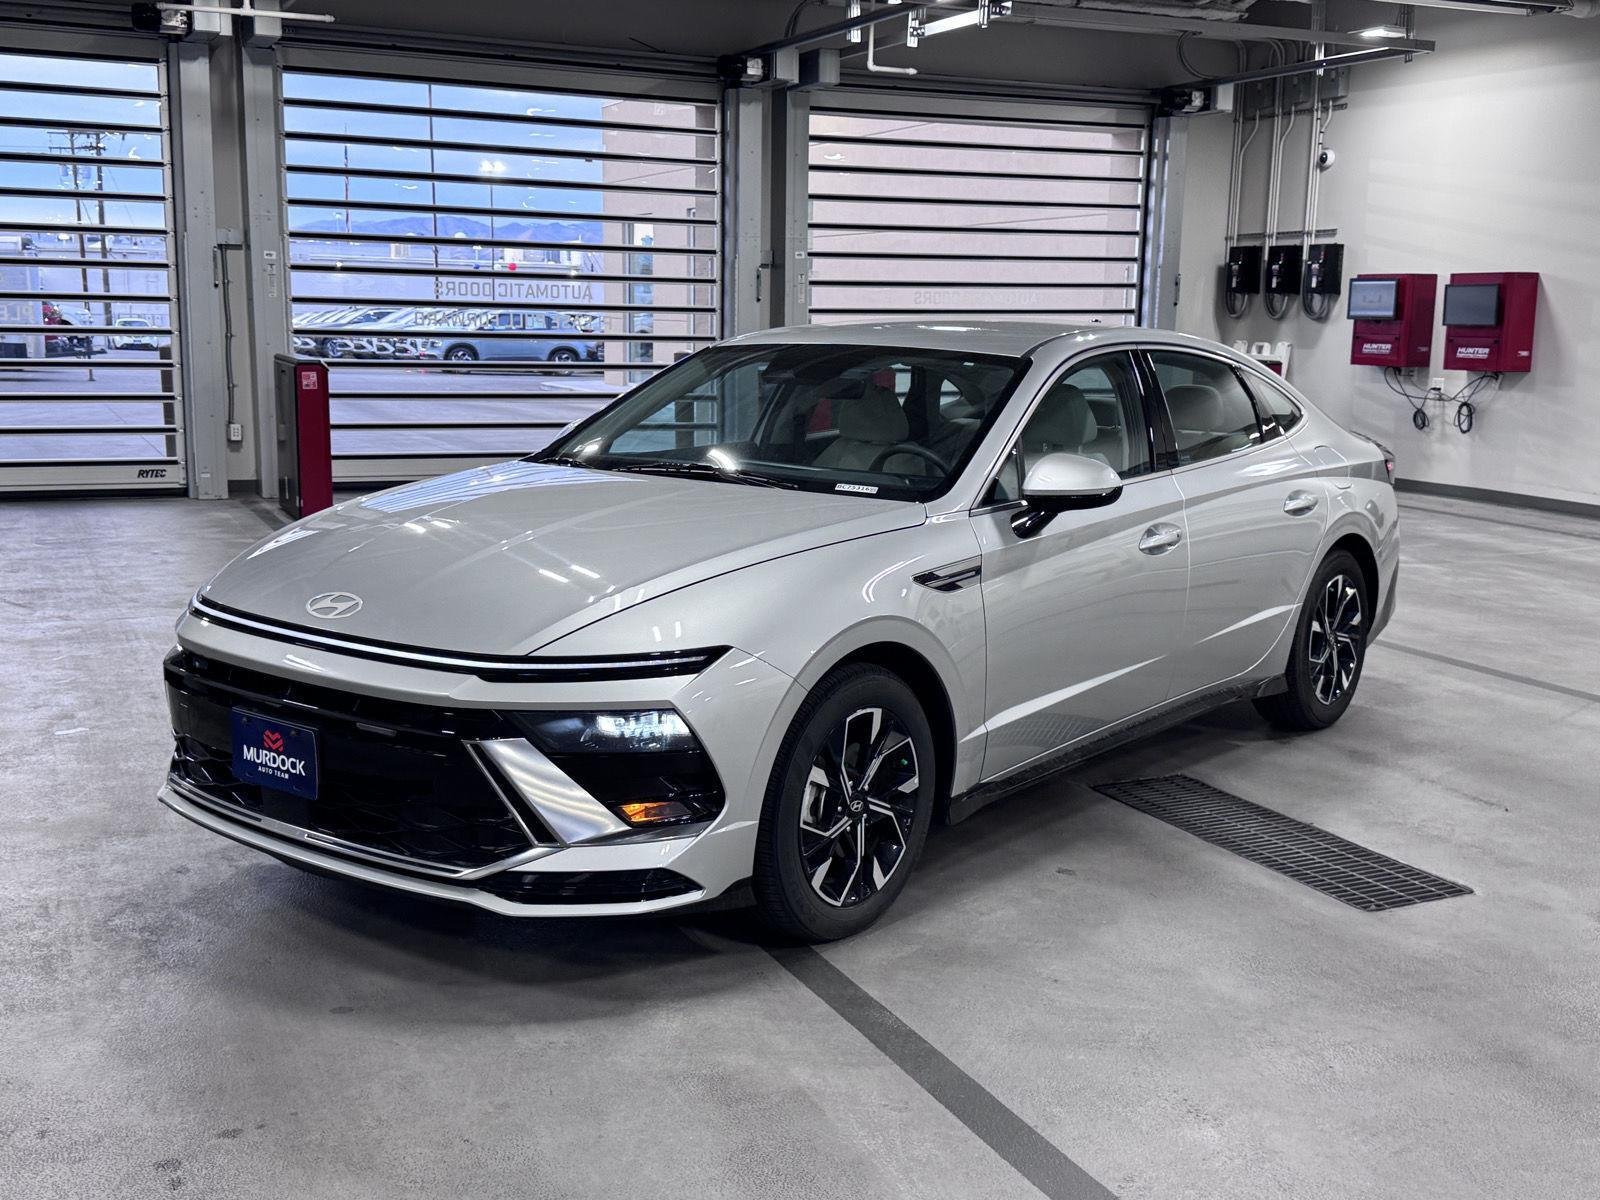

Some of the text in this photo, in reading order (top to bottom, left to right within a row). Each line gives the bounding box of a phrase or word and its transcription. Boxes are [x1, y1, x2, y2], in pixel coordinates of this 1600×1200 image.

[1362, 343, 1392, 351] HUNTER
[1457, 346, 1490, 355] HUNTER
[137, 468, 167, 479] RYTEC
[243, 744, 306, 777] MURDOCK
[258, 766, 289, 779] AUTO TEAM
